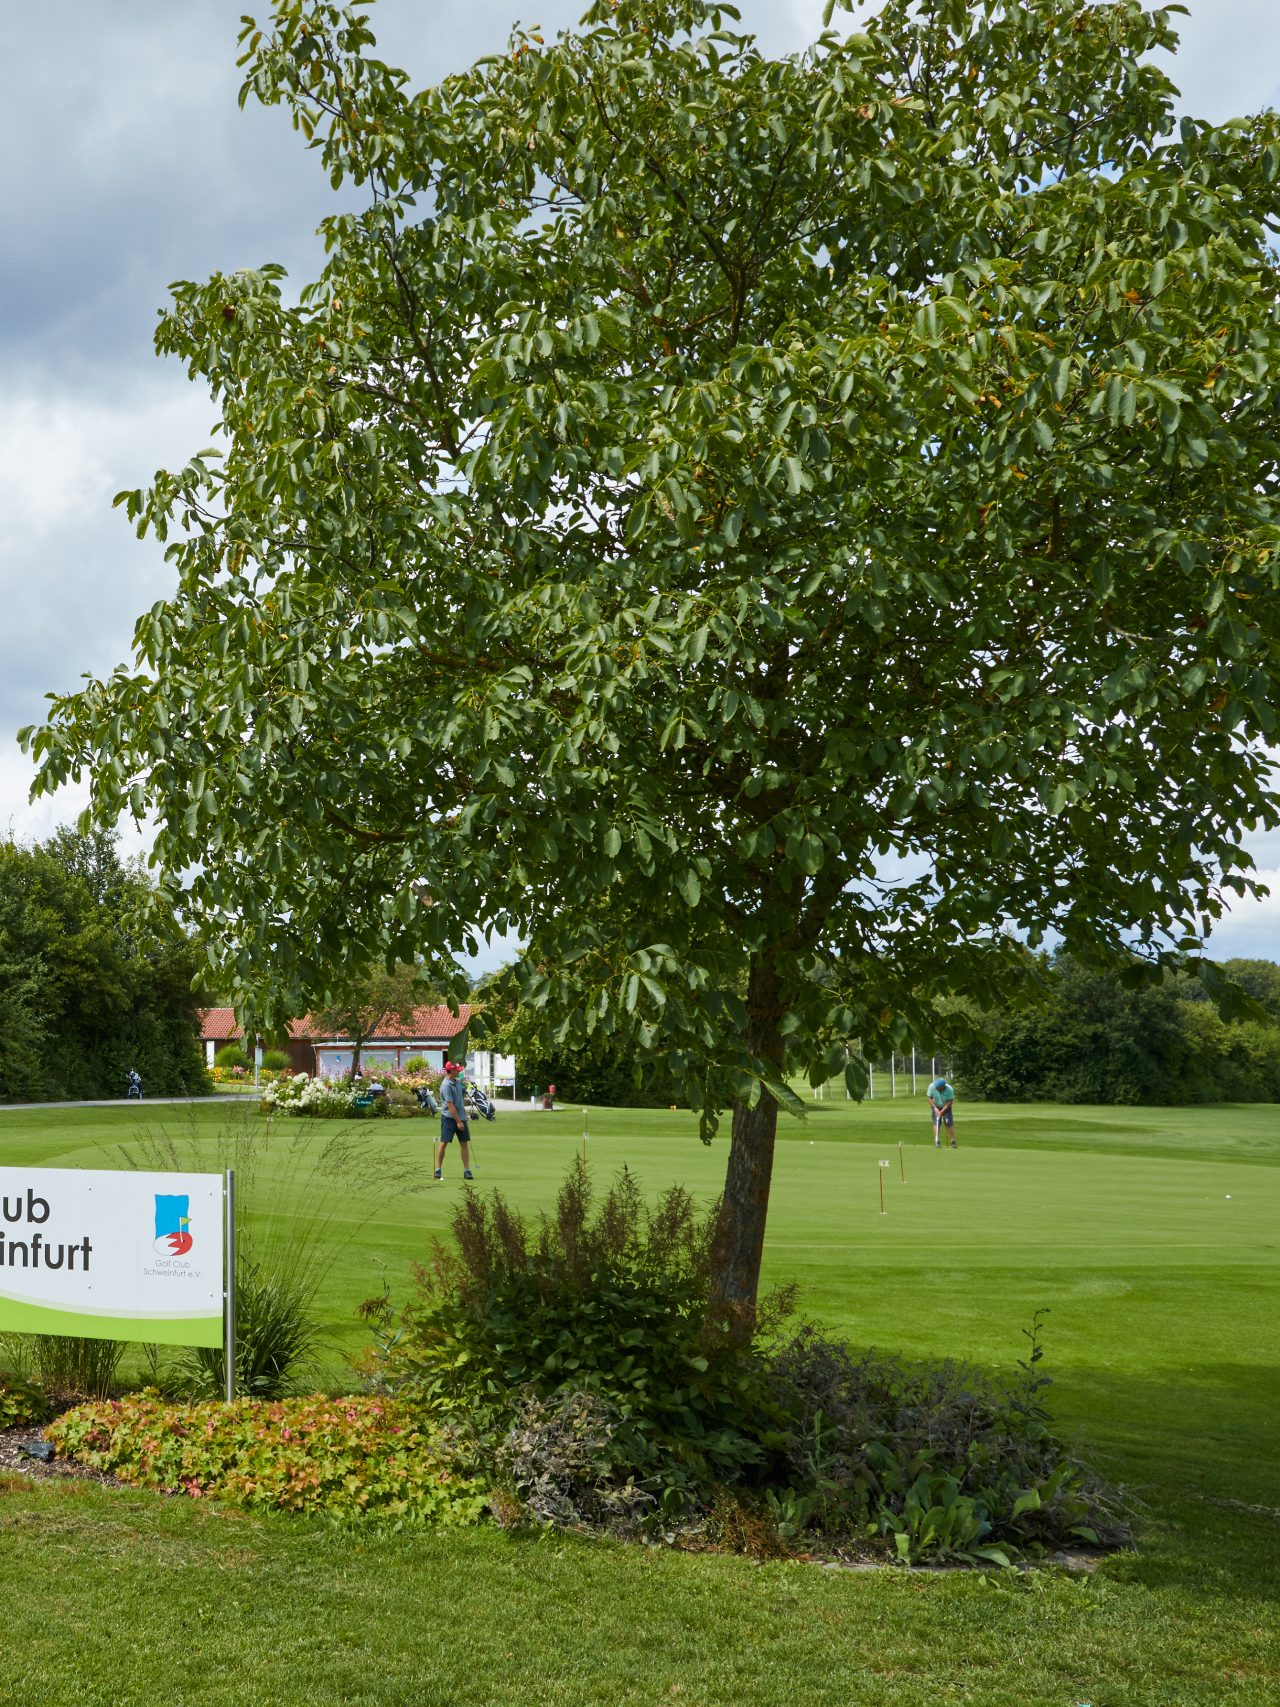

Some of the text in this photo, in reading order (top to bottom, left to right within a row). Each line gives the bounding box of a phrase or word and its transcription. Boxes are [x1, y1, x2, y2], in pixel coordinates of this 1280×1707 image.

[155, 1259, 191, 1269] Golf Club
[143, 1267, 186, 1277] Schweinfurt
